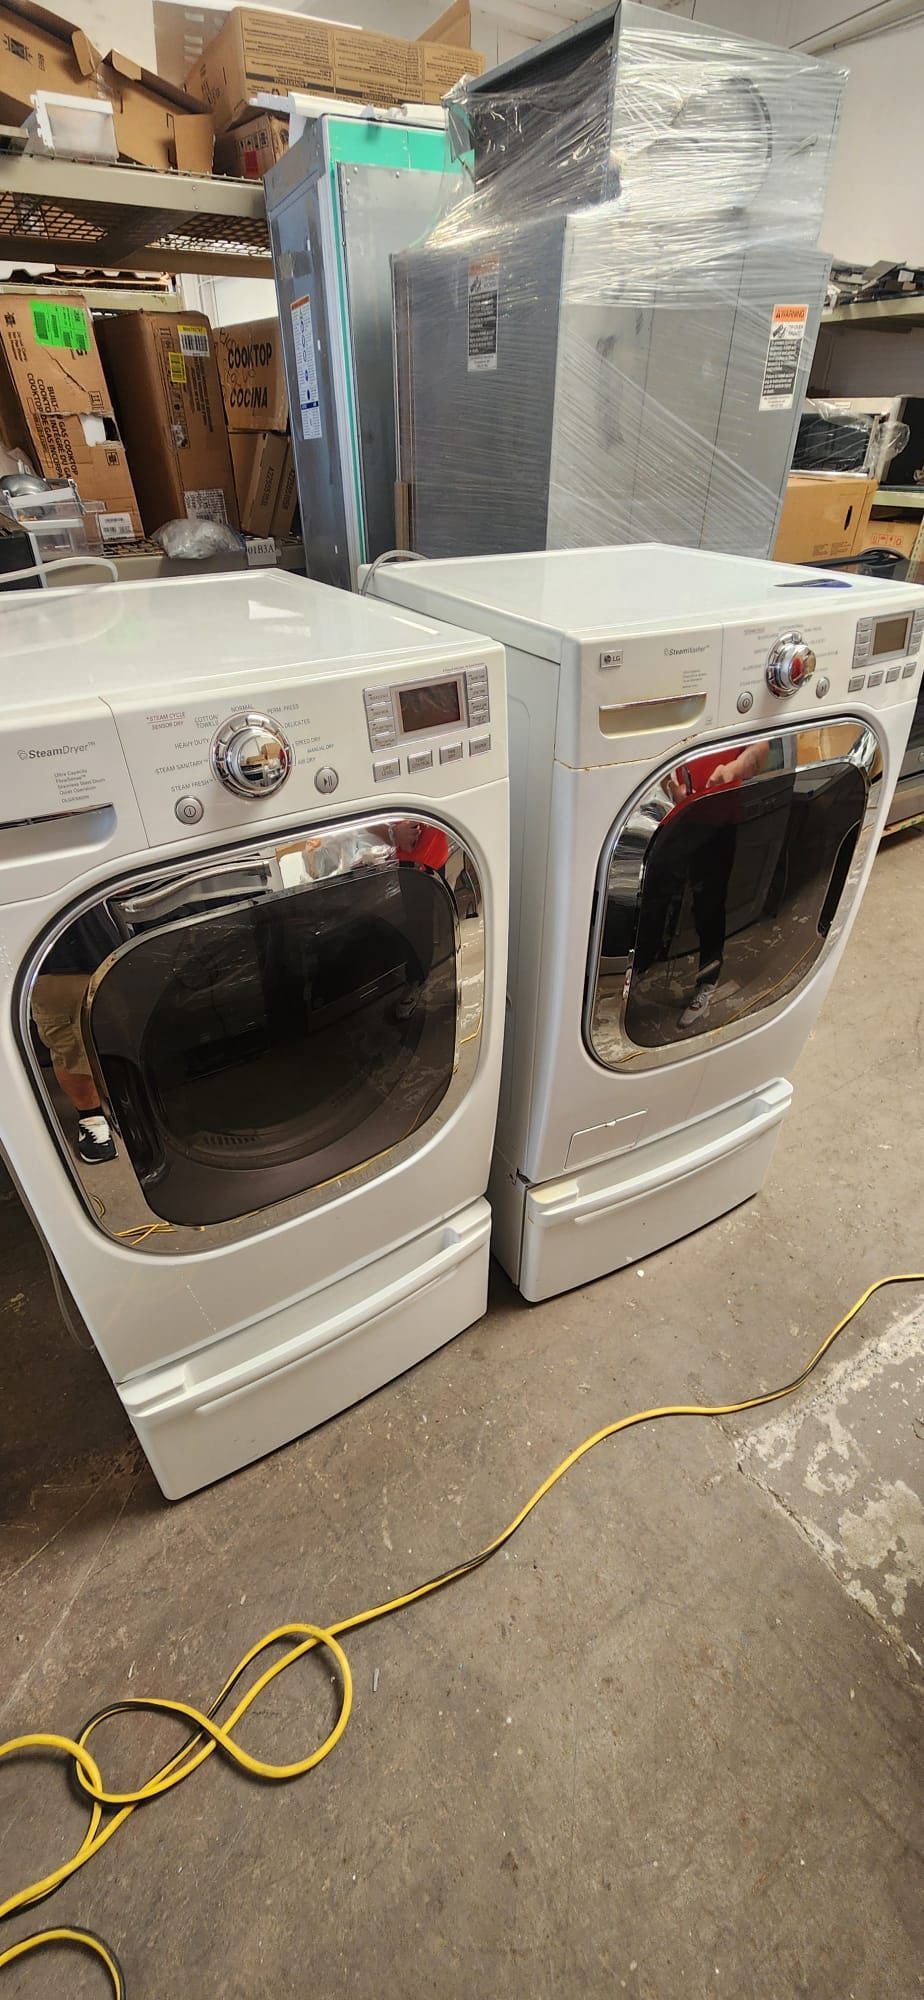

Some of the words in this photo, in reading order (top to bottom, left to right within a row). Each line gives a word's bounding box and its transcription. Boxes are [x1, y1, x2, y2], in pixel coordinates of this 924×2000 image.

[780, 309, 805, 319] WARNING
[228, 342, 272, 369] COOKTOP
[27, 372, 43, 412] COOKTOP
[230, 386, 268, 409] COCINA
[41, 414, 48, 427] DE
[44, 427, 53, 443] GAS
[59, 421, 68, 438] GAS
[63, 439, 78, 475] COOKTOP
[231, 704, 254, 712] NORMAL
[284, 719, 311, 728] DELICATES
[175, 741, 193, 749] HEAVY
[155, 766, 175, 774] STEAM
[171, 783, 190, 792] STEAM
